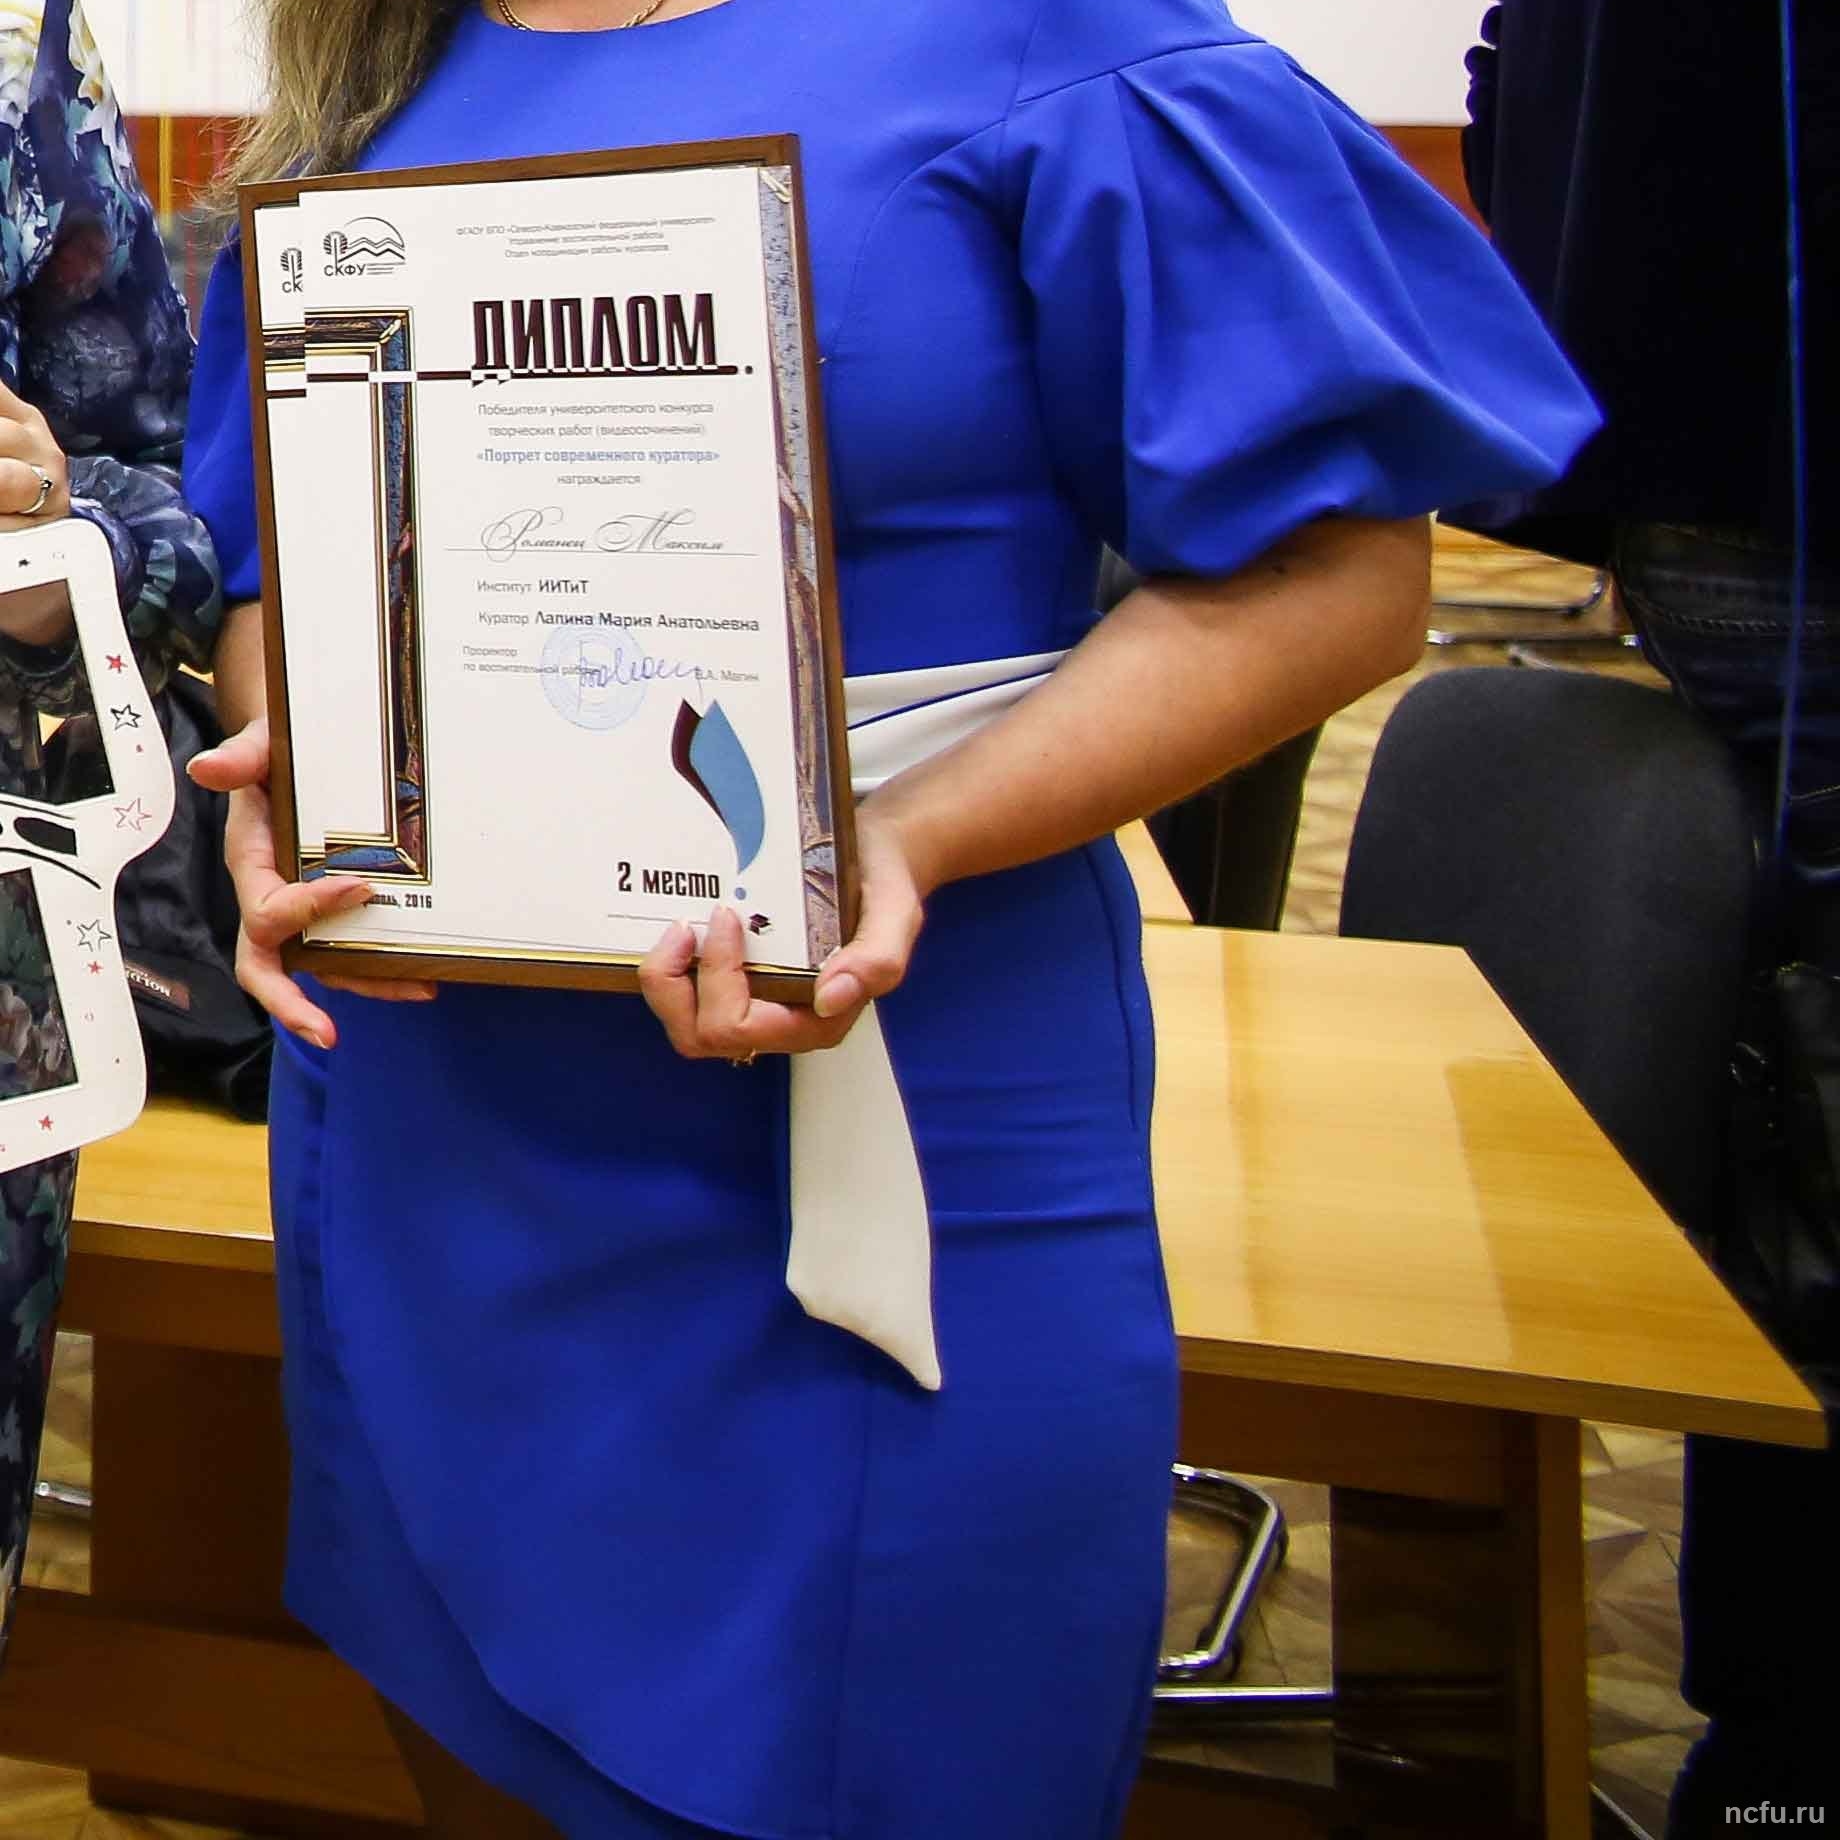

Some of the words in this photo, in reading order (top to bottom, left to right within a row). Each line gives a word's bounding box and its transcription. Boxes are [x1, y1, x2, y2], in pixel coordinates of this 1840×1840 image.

[323, 263, 366, 277] СКФУ
[281, 280, 303, 293] СК
[471, 292, 718, 382] ДИПЛОМ
[550, 404, 657, 417] университетского
[558, 423, 594, 438] работ
[544, 450, 646, 463] современного
[477, 579, 533, 595] Институт
[538, 578, 590, 594] ИИТиТ
[478, 611, 530, 627] Куратор
[535, 610, 594, 627] Лапина
[599, 612, 653, 628] Мария
[656, 614, 761, 632] Анатольевна
[617, 861, 632, 892] 2
[642, 868, 720, 900] место
[405, 892, 433, 910] 2016
